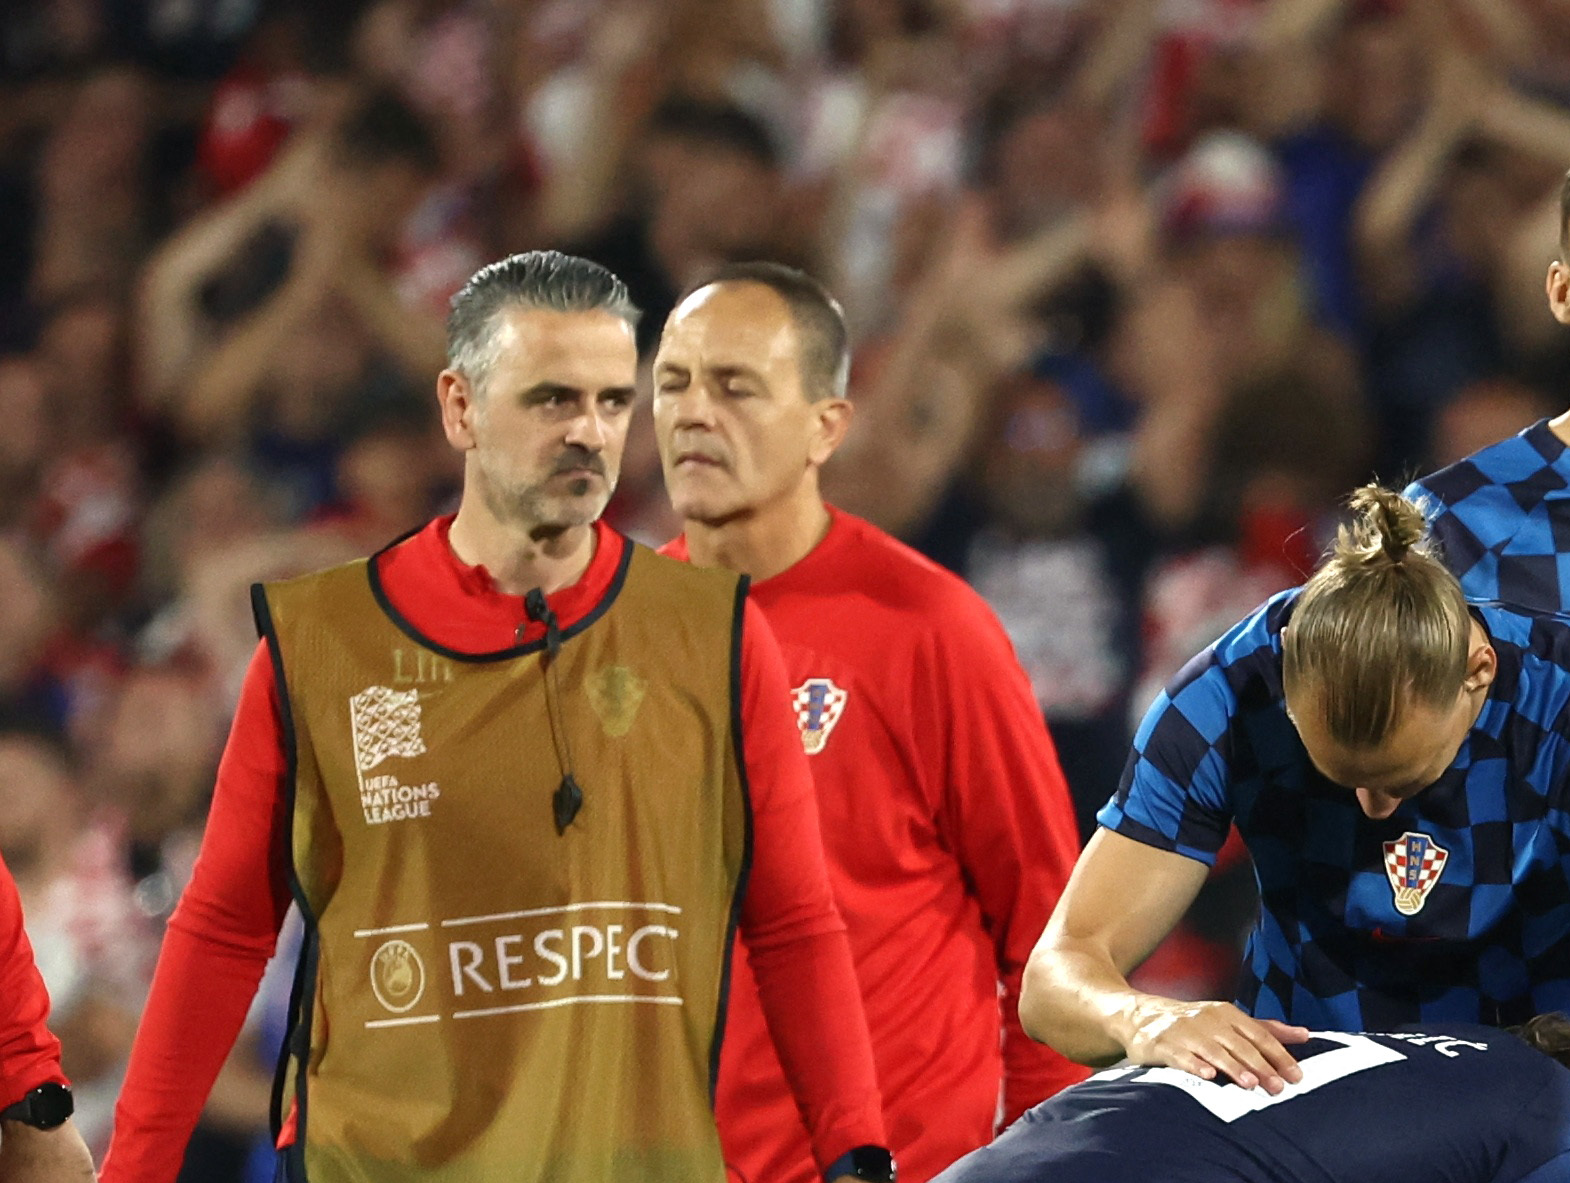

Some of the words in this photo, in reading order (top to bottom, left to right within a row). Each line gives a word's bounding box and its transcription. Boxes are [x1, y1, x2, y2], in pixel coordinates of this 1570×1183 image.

[361, 782, 441, 808] NATIONS
[365, 775, 399, 792] UEFA
[364, 799, 432, 825] LEAGUE
[1408, 841, 1422, 881] HNS
[449, 923, 680, 997] RESPEC
